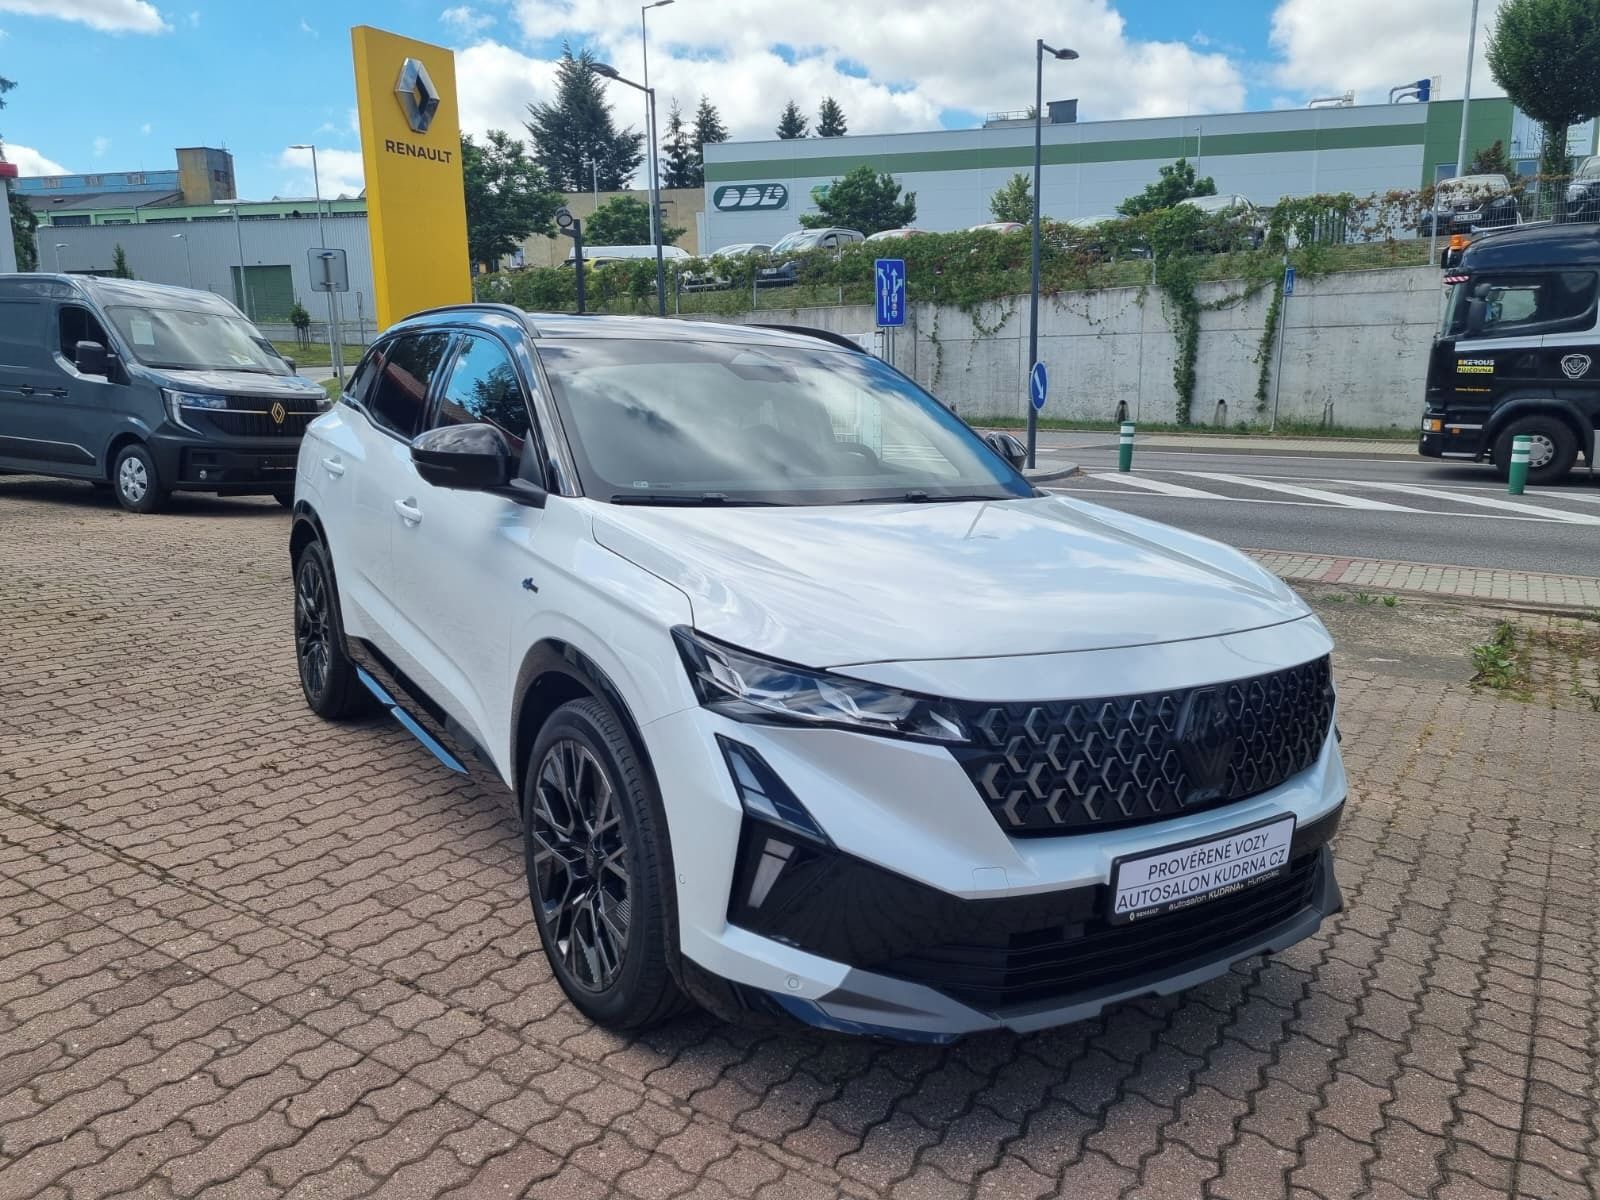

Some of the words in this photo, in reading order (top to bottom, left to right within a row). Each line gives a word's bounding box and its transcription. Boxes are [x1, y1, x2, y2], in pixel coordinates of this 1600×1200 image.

[385, 139, 452, 164] RENAULT
[1148, 841, 1232, 880] PROVĚŘENÉ
[1235, 833, 1269, 855] VOZY
[1117, 872, 1210, 911] AUTOSALON
[1214, 855, 1266, 885] KUDRNA
[1270, 849, 1286, 866] CZ
[1168, 894, 1207, 911] autosalon
